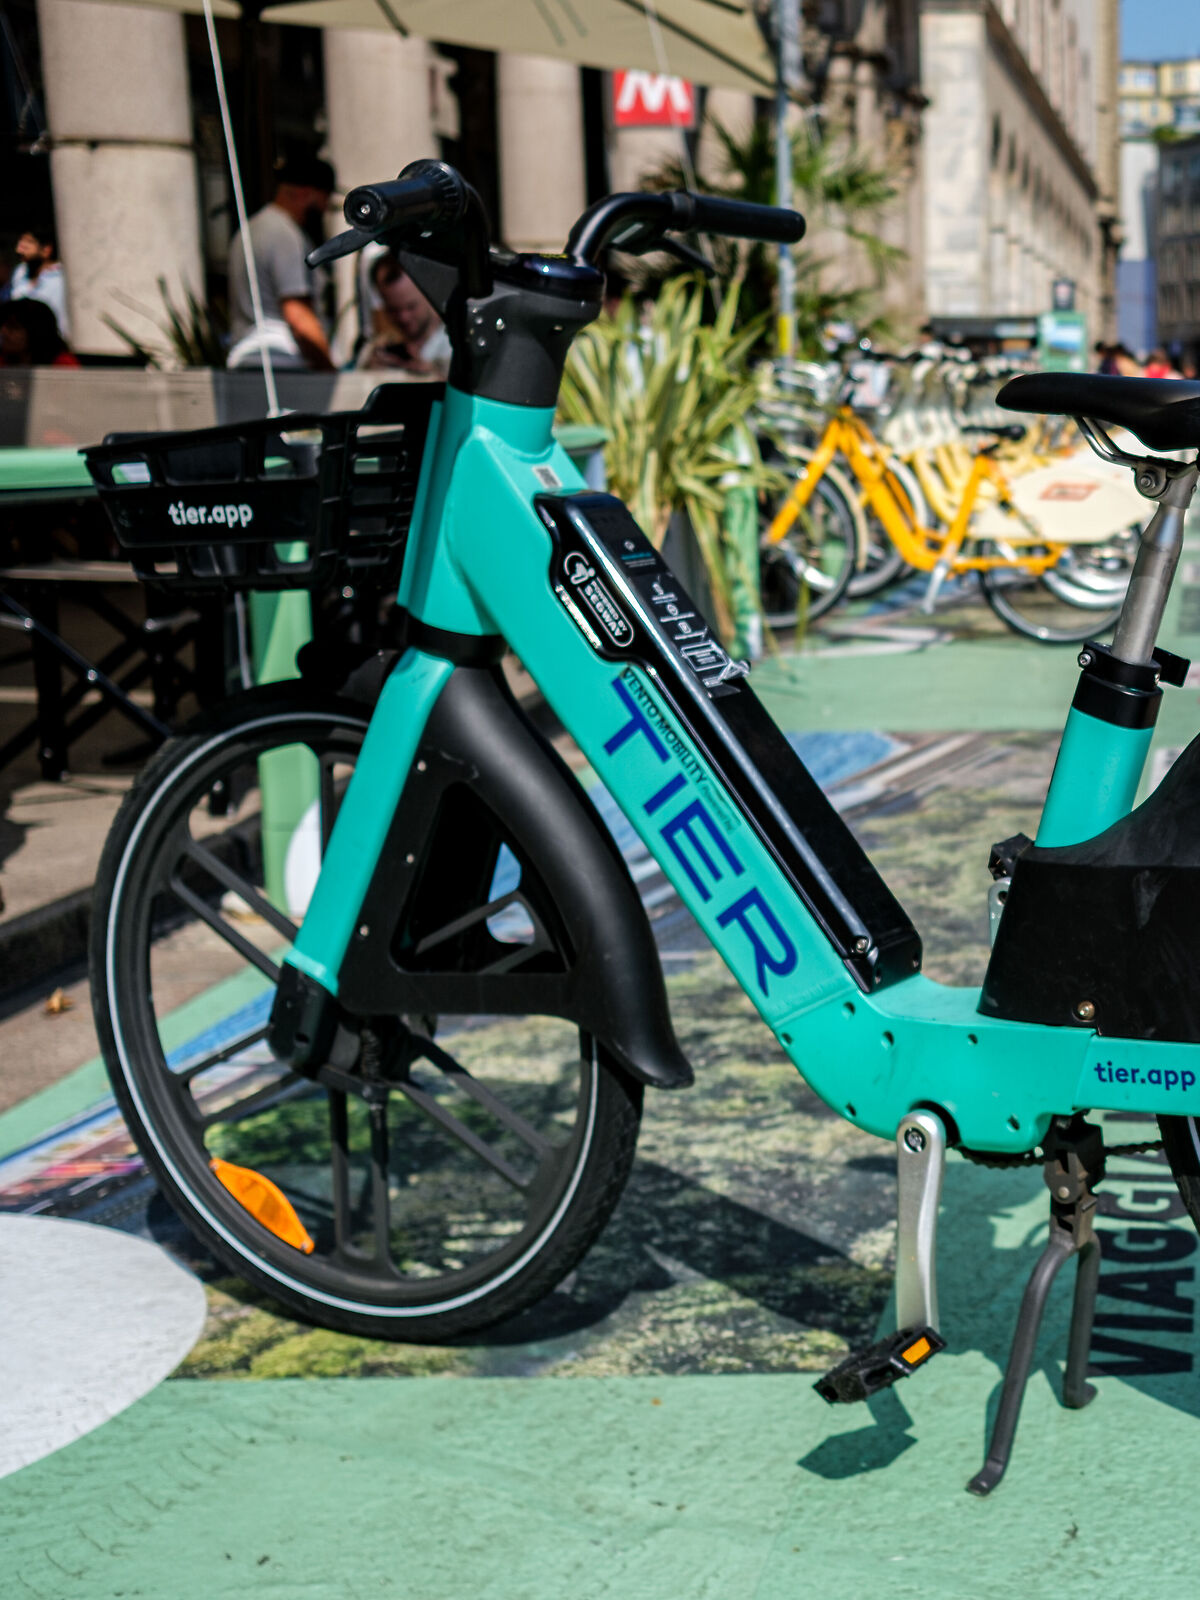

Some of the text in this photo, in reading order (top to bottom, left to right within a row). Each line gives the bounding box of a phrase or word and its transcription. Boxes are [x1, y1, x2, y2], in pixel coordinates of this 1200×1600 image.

[617, 69, 691, 112] M
[168, 500, 253, 528] tier.app
[582, 584, 623, 638] SEGWAY
[590, 580, 628, 632] POWERED BY
[619, 667, 660, 719] VENTO
[654, 717, 707, 786] MOBILITY
[604, 678, 798, 997] TIER
[1094, 1060, 1196, 1091] tier.app
